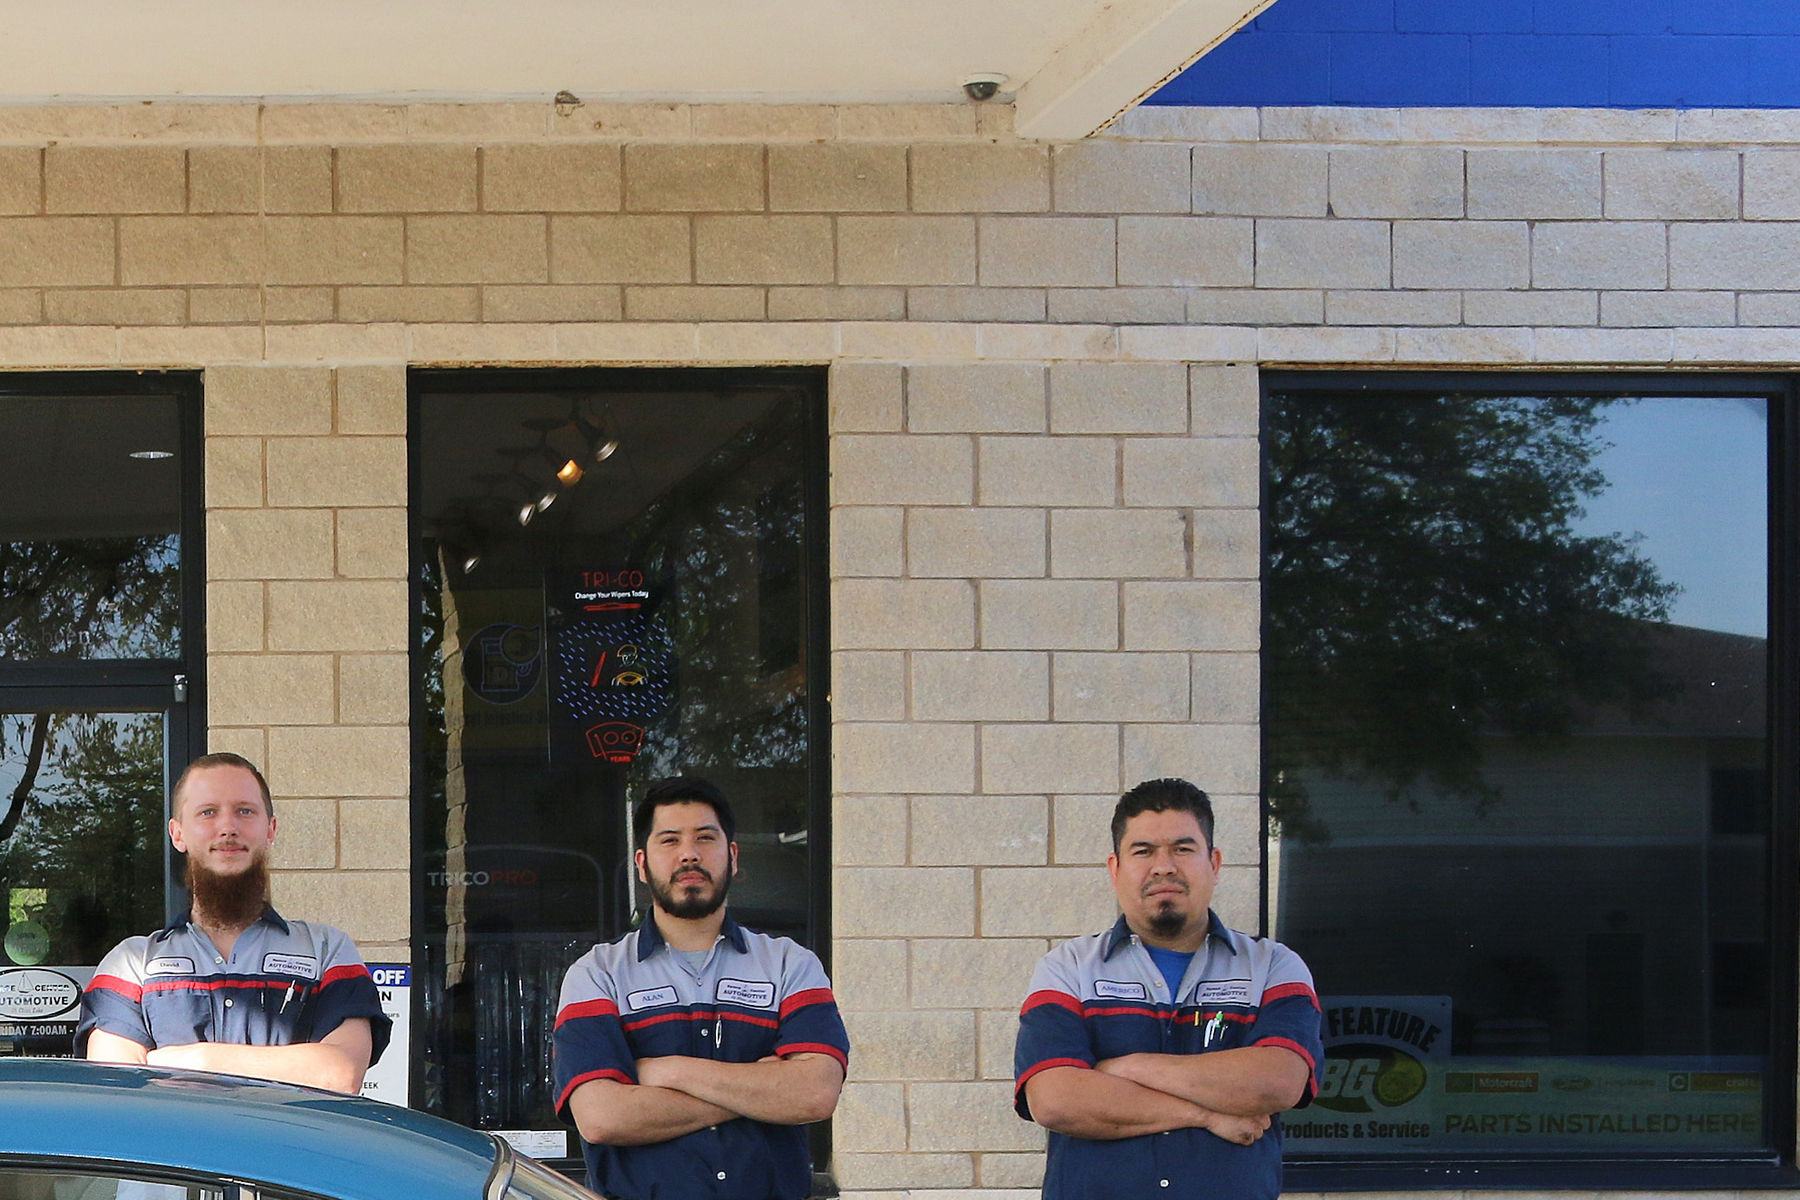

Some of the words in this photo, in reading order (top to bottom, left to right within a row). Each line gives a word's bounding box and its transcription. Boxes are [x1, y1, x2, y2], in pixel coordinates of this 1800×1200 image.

[574, 591, 597, 600] Change
[597, 591, 611, 599] Your
[611, 591, 631, 600] Wipers
[631, 590, 649, 599] Today
[268, 963, 313, 974] AUTOMOTIVE
[372, 969, 406, 985] OFF
[642, 993, 664, 1002] ALAN
[723, 989, 768, 1000] AUTOMOTIVE
[1201, 990, 1247, 998] AUTOMOTIVE
[29, 1025, 67, 1035] 7:00AM
[1327, 1006, 1442, 1053] FEATURE
[1319, 1058, 1381, 1099] BG
[1479, 1077, 1534, 1089] Motorcraft
[1444, 1113, 1532, 1134] PARTS
[1538, 1113, 1681, 1134] INSTALLED
[1687, 1113, 1757, 1134] HERE
[1353, 1122, 1365, 1138] &
[1367, 1121, 1430, 1138] Service
